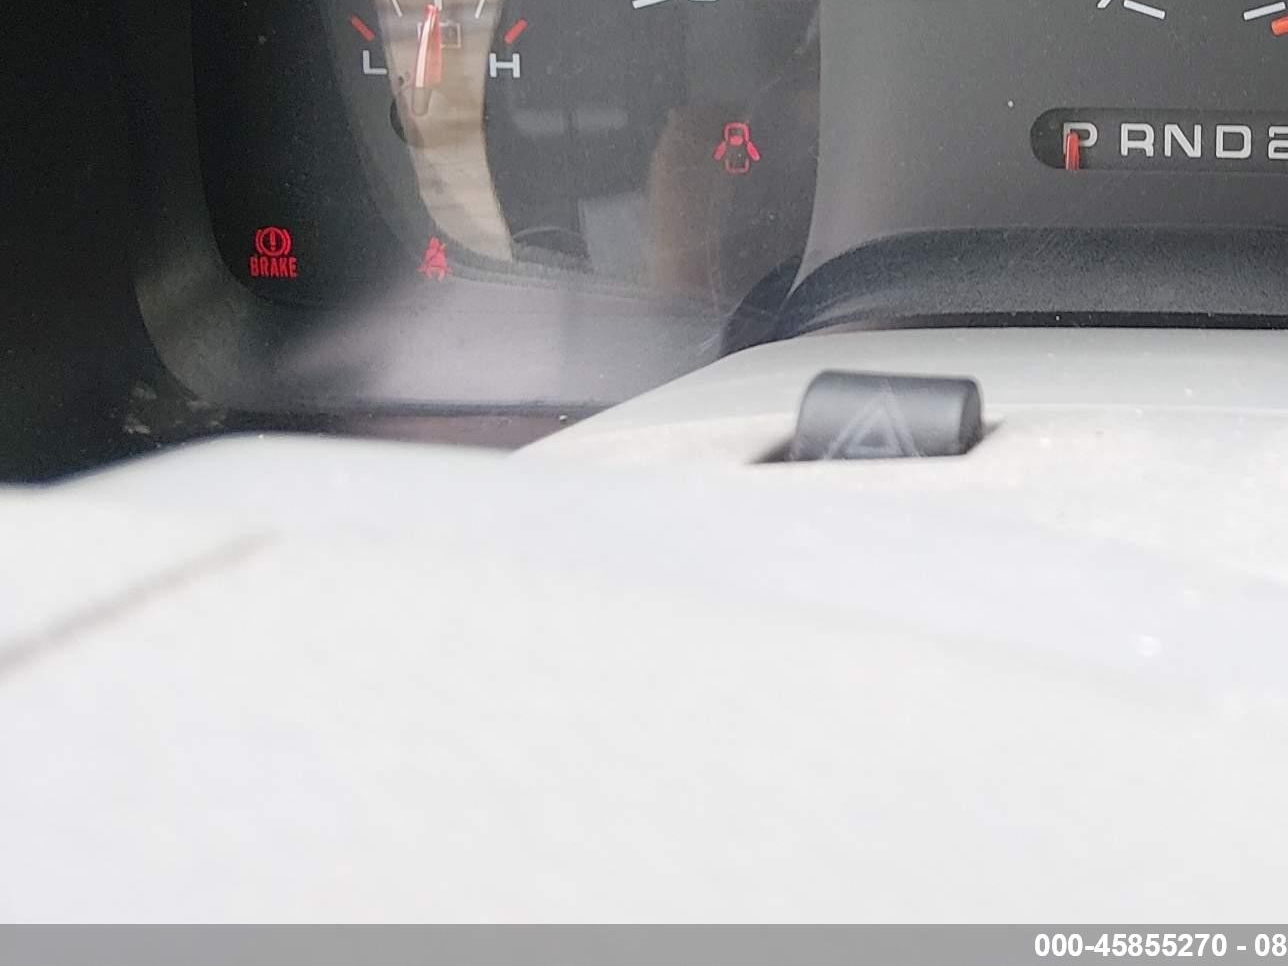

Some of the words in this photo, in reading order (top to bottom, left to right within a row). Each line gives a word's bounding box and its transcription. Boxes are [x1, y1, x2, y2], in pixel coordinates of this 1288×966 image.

[363, 50, 387, 75] L
[489, 52, 521, 78] H
[251, 256, 298, 277] BRAKE
